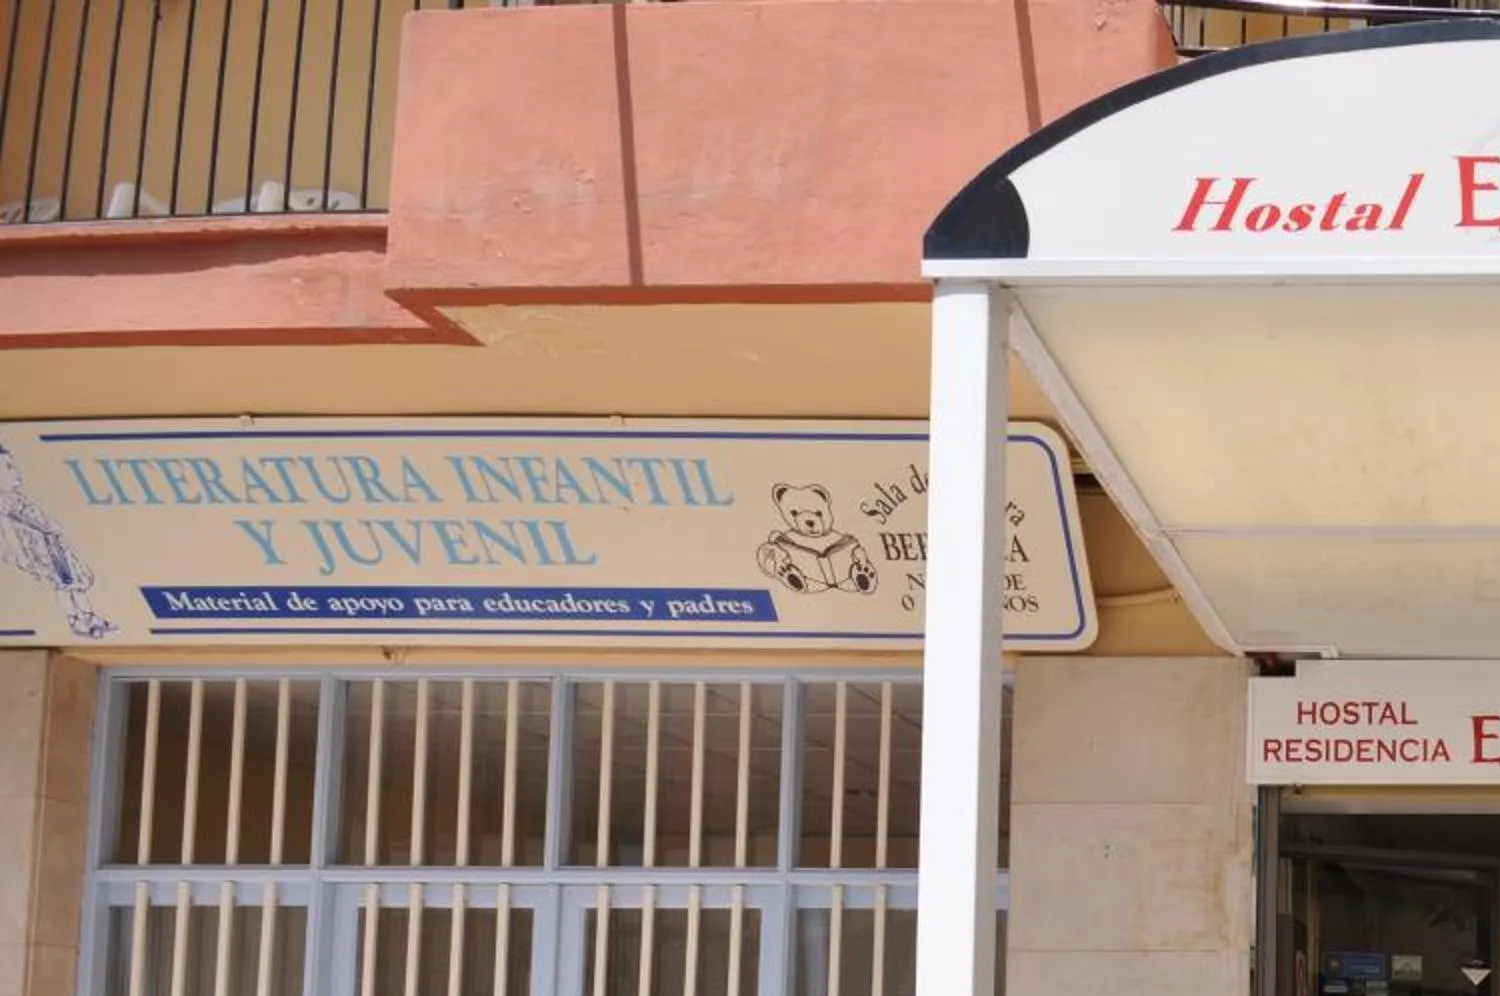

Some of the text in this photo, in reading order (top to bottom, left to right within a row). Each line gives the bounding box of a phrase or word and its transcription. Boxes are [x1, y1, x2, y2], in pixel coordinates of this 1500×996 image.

[1171, 172, 1424, 232] Hostal
[65, 455, 733, 507] LITERATURA INFANTIL
[859, 482, 908, 526] Sala
[234, 519, 597, 577] Y JUVENIL
[162, 591, 754, 618] Material de apoyo para educadores y padres
[1297, 701, 1418, 725] HOSTAL
[1262, 738, 1451, 763] RESIDENCIA
